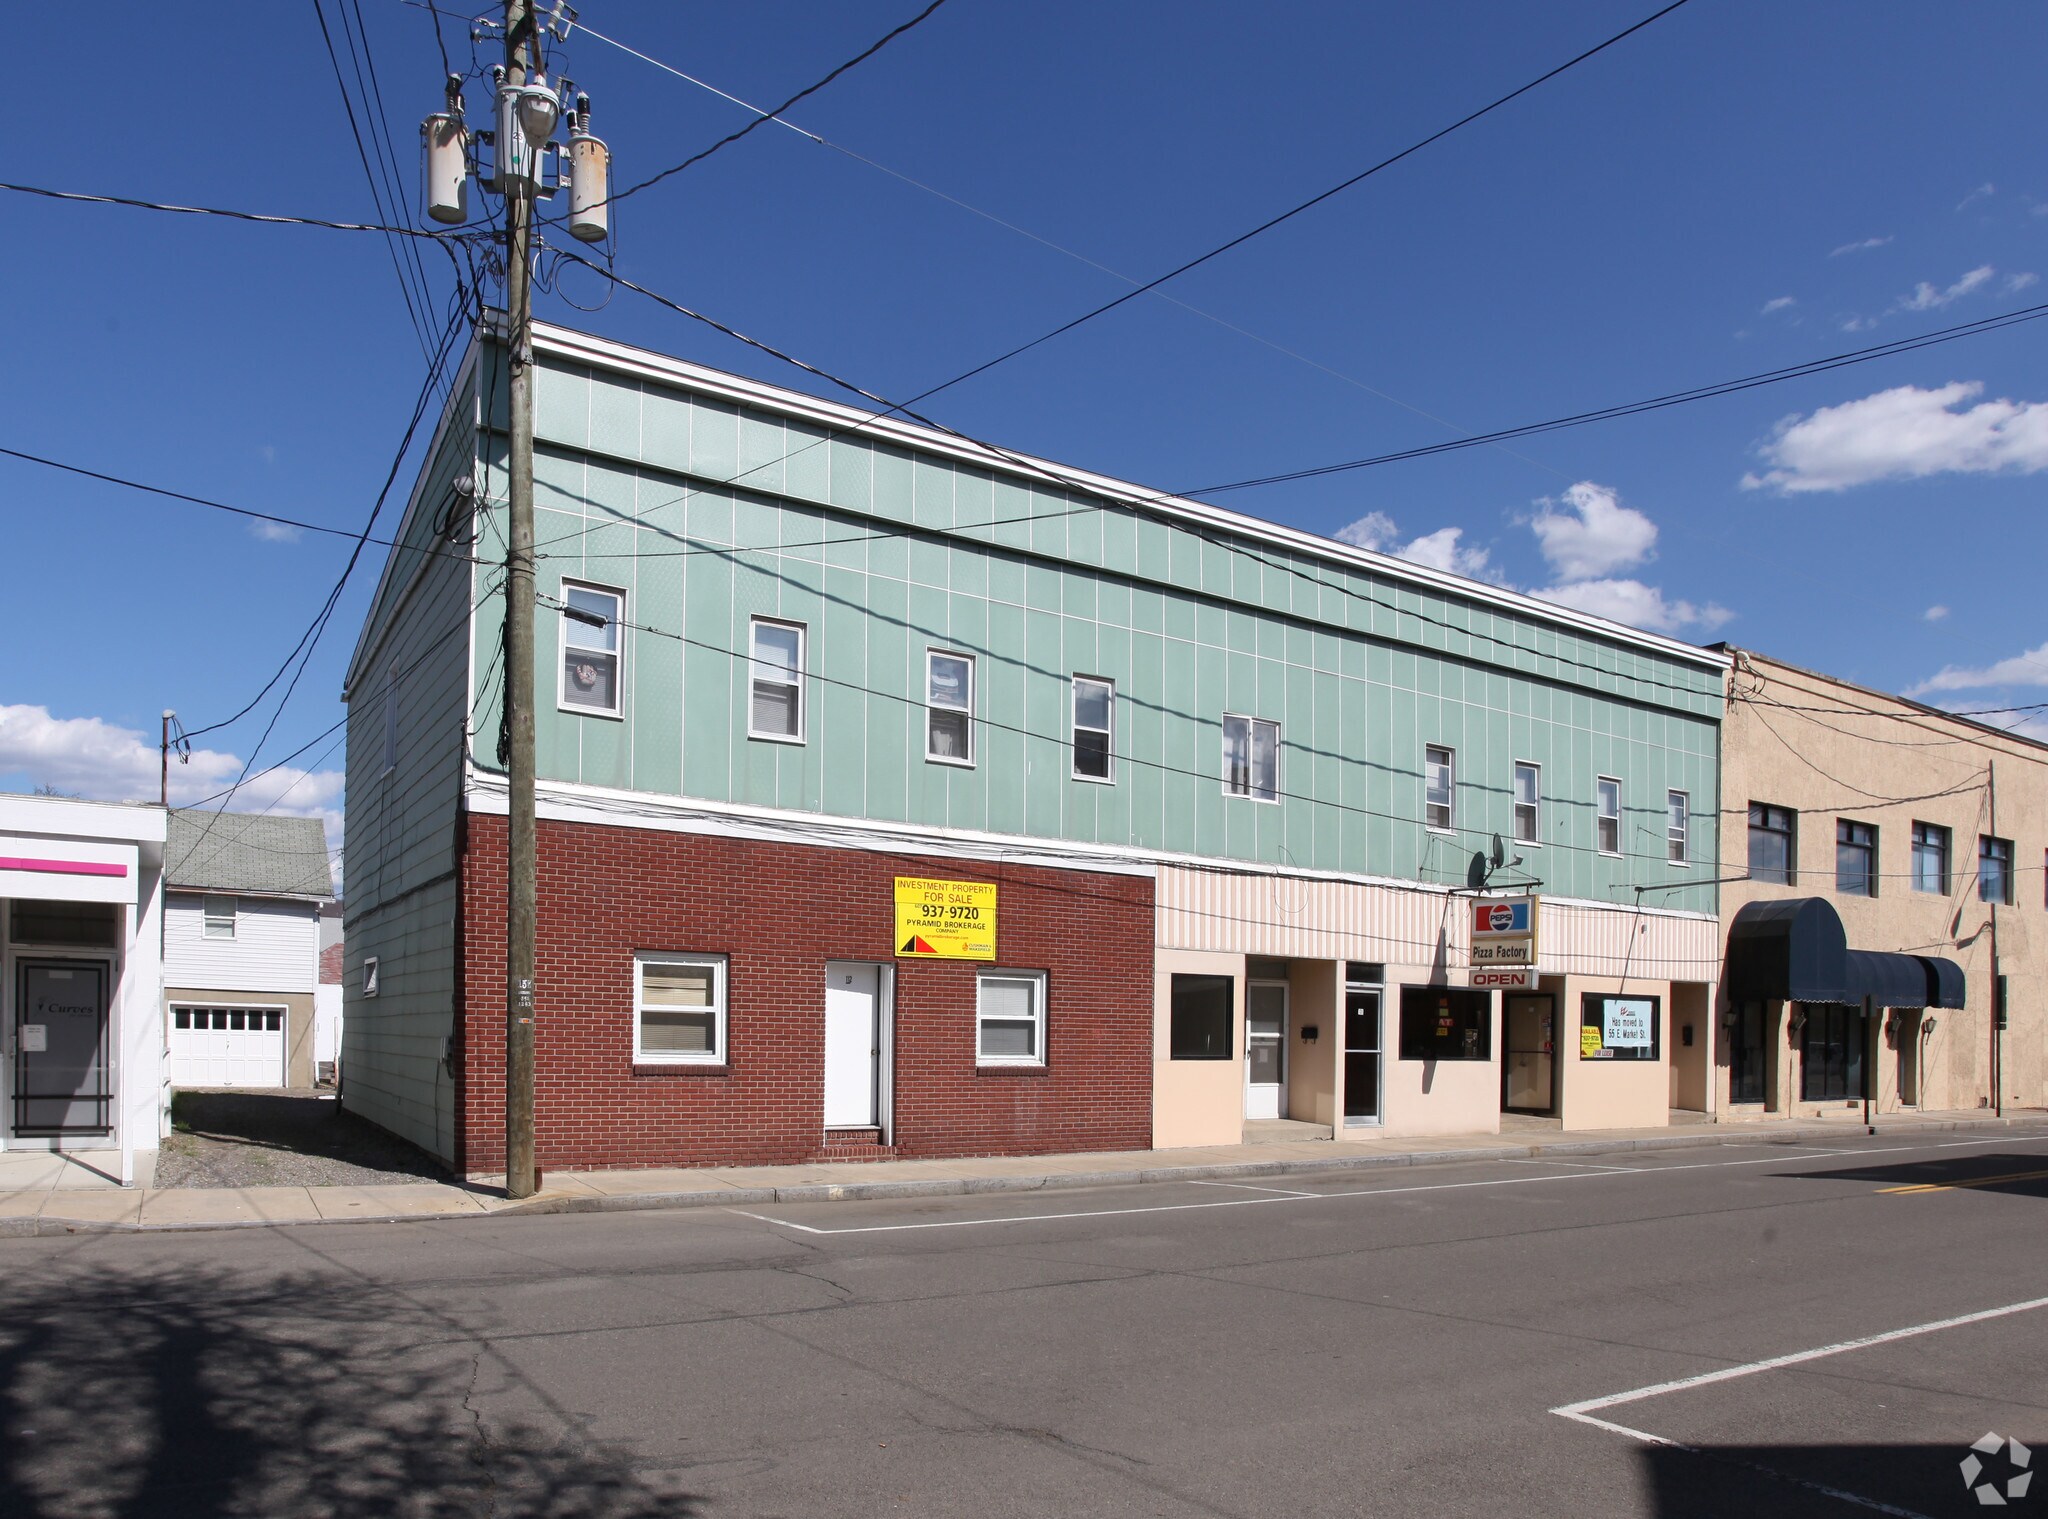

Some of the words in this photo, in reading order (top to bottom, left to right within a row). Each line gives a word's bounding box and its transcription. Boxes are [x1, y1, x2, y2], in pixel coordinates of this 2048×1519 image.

[898, 880, 949, 892] INVESTMENT
[952, 885, 994, 894] PROPERTY
[924, 892, 944, 902] FOR
[948, 894, 972, 904] SALE
[922, 904, 979, 920] 937-9720
[906, 919, 941, 928] PYRAMID
[944, 921, 986, 930] BROKERAGE
[1473, 946, 1492, 958] Pizza
[1496, 946, 1527, 960] Factory
[1474, 974, 1525, 985] OPEN
[48, 1003, 94, 1014] Curves
[1612, 1017, 1620, 1026] Has
[1623, 1018, 1637, 1027] moved
[1608, 1029, 1615, 1038] 55
[1623, 1029, 1638, 1039] Market
